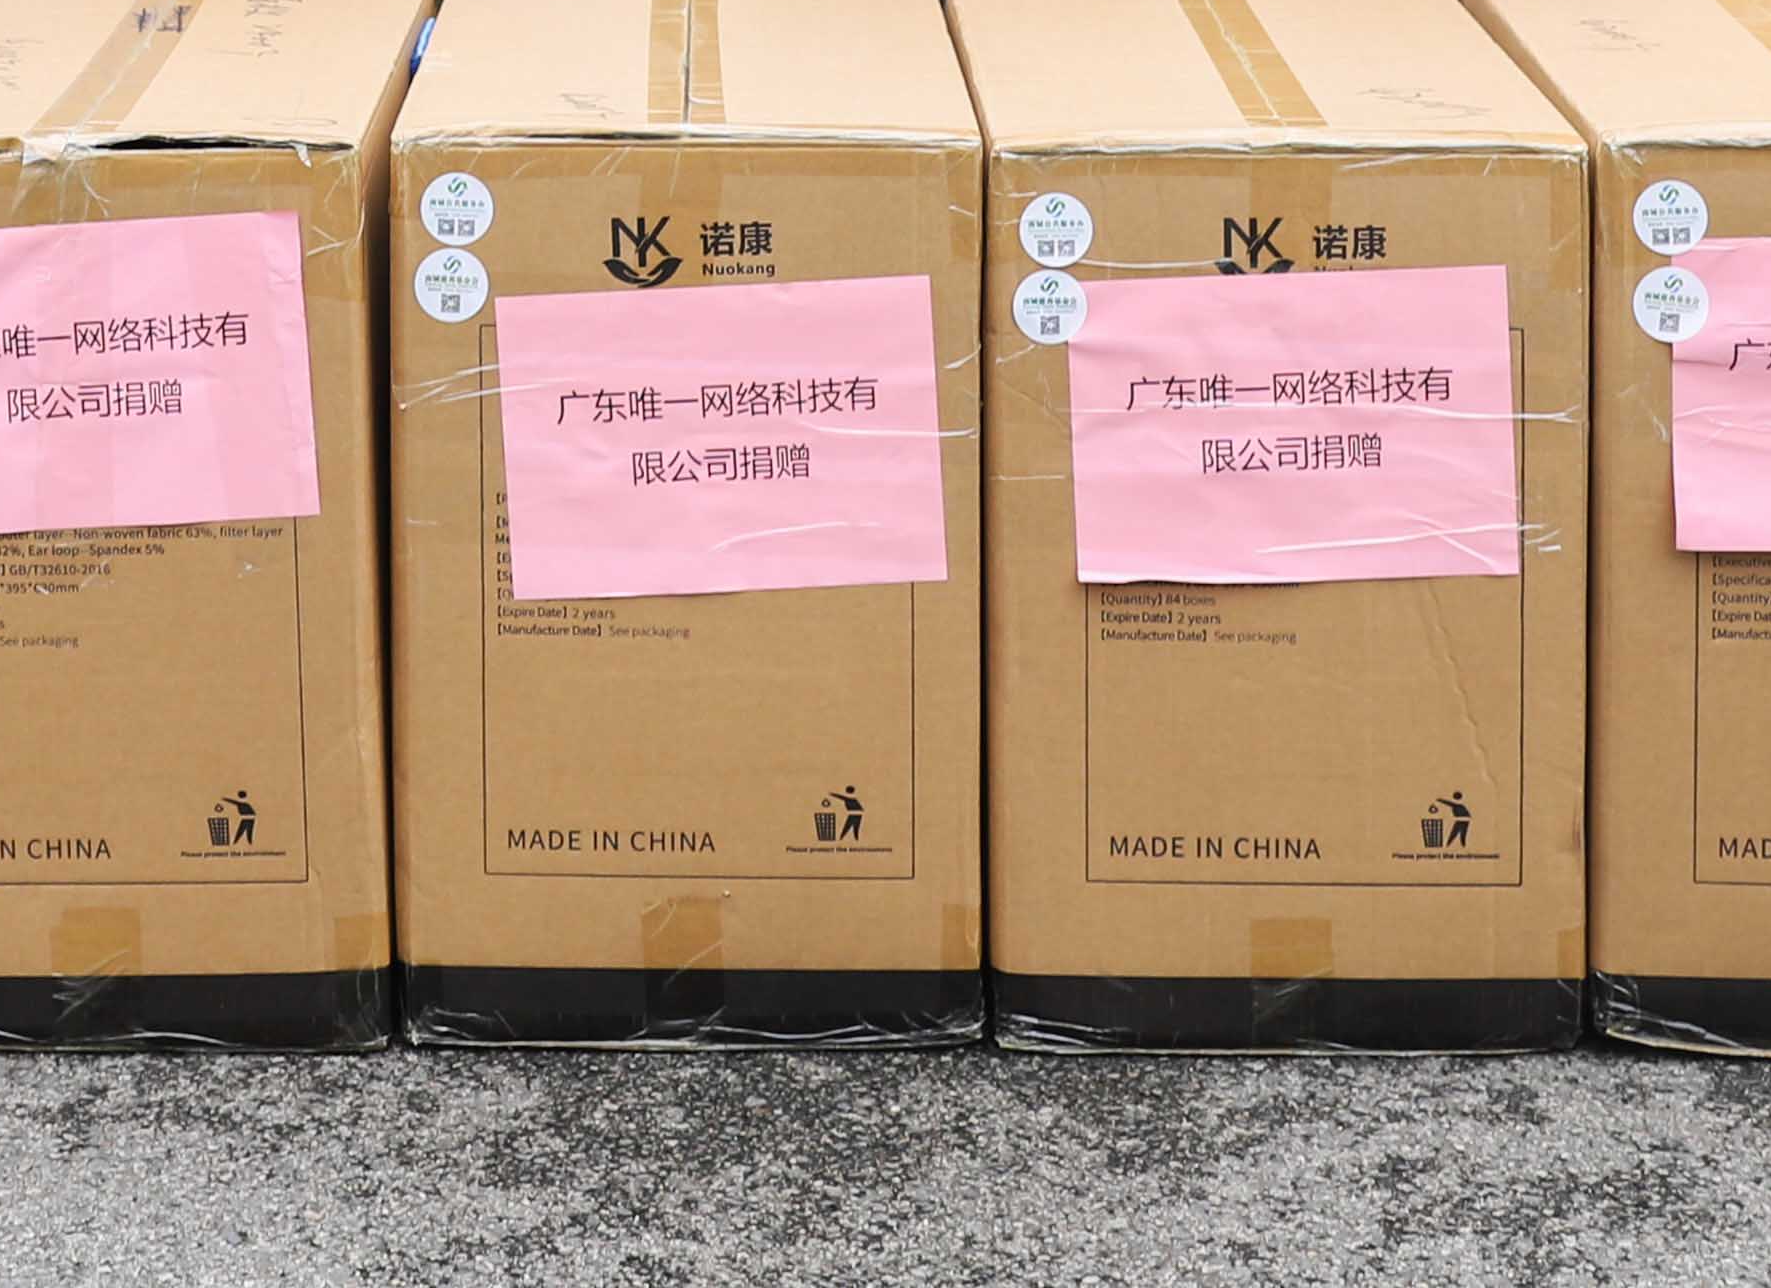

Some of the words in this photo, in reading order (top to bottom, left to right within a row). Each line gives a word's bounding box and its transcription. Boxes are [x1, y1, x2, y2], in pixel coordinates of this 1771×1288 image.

[700, 220, 774, 257] 诺康
[1312, 224, 1388, 261] 诺康
[701, 262, 776, 278] Nuokang
[1125, 365, 1452, 411] 广东唯一网络科技有
[7, 378, 184, 424] 限公司捐赠
[556, 376, 879, 425] 广东唯一网络科技有
[1200, 433, 1382, 474] 限公司捐赠
[630, 443, 811, 487] 限公司捐赠
[220, 525, 249, 539] filter
[252, 524, 284, 541] layer
[28, 544, 49, 557] Ear
[146, 544, 165, 556] 5%
[1183, 593, 1216, 606] boxes
[572, 607, 580, 619] 2
[583, 608, 616, 621] years
[1177, 612, 1185, 624] 2
[1188, 613, 1221, 625] years
[0, 636, 19, 647] See
[22, 636, 79, 649] packaging
[609, 625, 631, 637] See
[633, 626, 691, 639] packaging
[1214, 631, 1235, 642] See
[1236, 631, 1297, 644] packaging
[27, 838, 112, 860] CHINA
[507, 829, 581, 852] MADE
[592, 830, 619, 852] IN
[630, 830, 716, 853] CHINA
[1109, 835, 1186, 858] MADE
[1195, 836, 1223, 858] IN
[1234, 837, 1322, 860] CHINA
